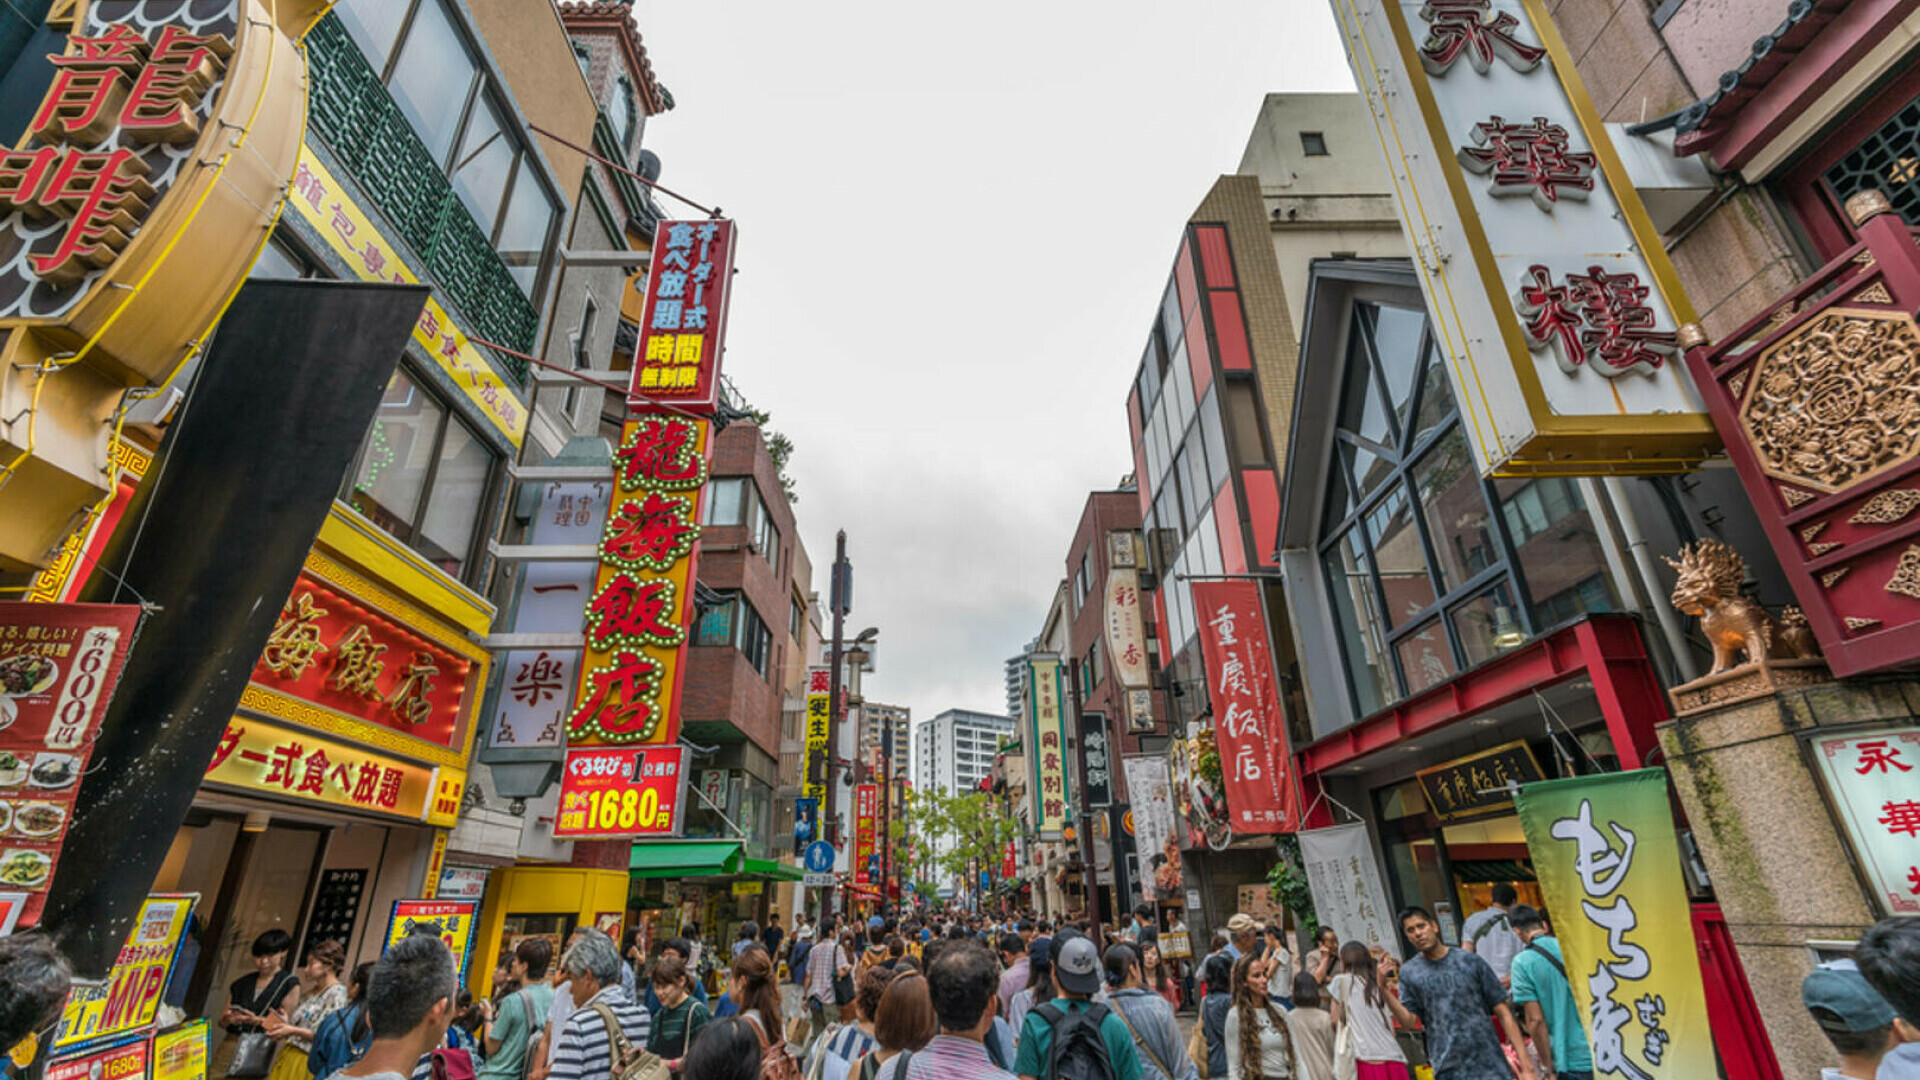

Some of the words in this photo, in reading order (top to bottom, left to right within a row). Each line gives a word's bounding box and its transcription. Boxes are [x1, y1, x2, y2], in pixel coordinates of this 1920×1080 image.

[0, 23, 215, 274] 龍門
[651, 221, 696, 329] 食べ放題
[684, 221, 719, 329] オーダー式
[639, 366, 699, 388] 無制限
[645, 333, 704, 364] 時間
[571, 419, 698, 734] 龍海飯店
[262, 591, 440, 725] 海飯店
[511, 582, 579, 708] 一楽
[810, 670, 829, 692] 薬
[1208, 604, 1262, 783] 重慶飯店
[569, 756, 623, 777] ぐるなび
[587, 787, 670, 830] 1680円
[96, 965, 164, 1034] MVP
